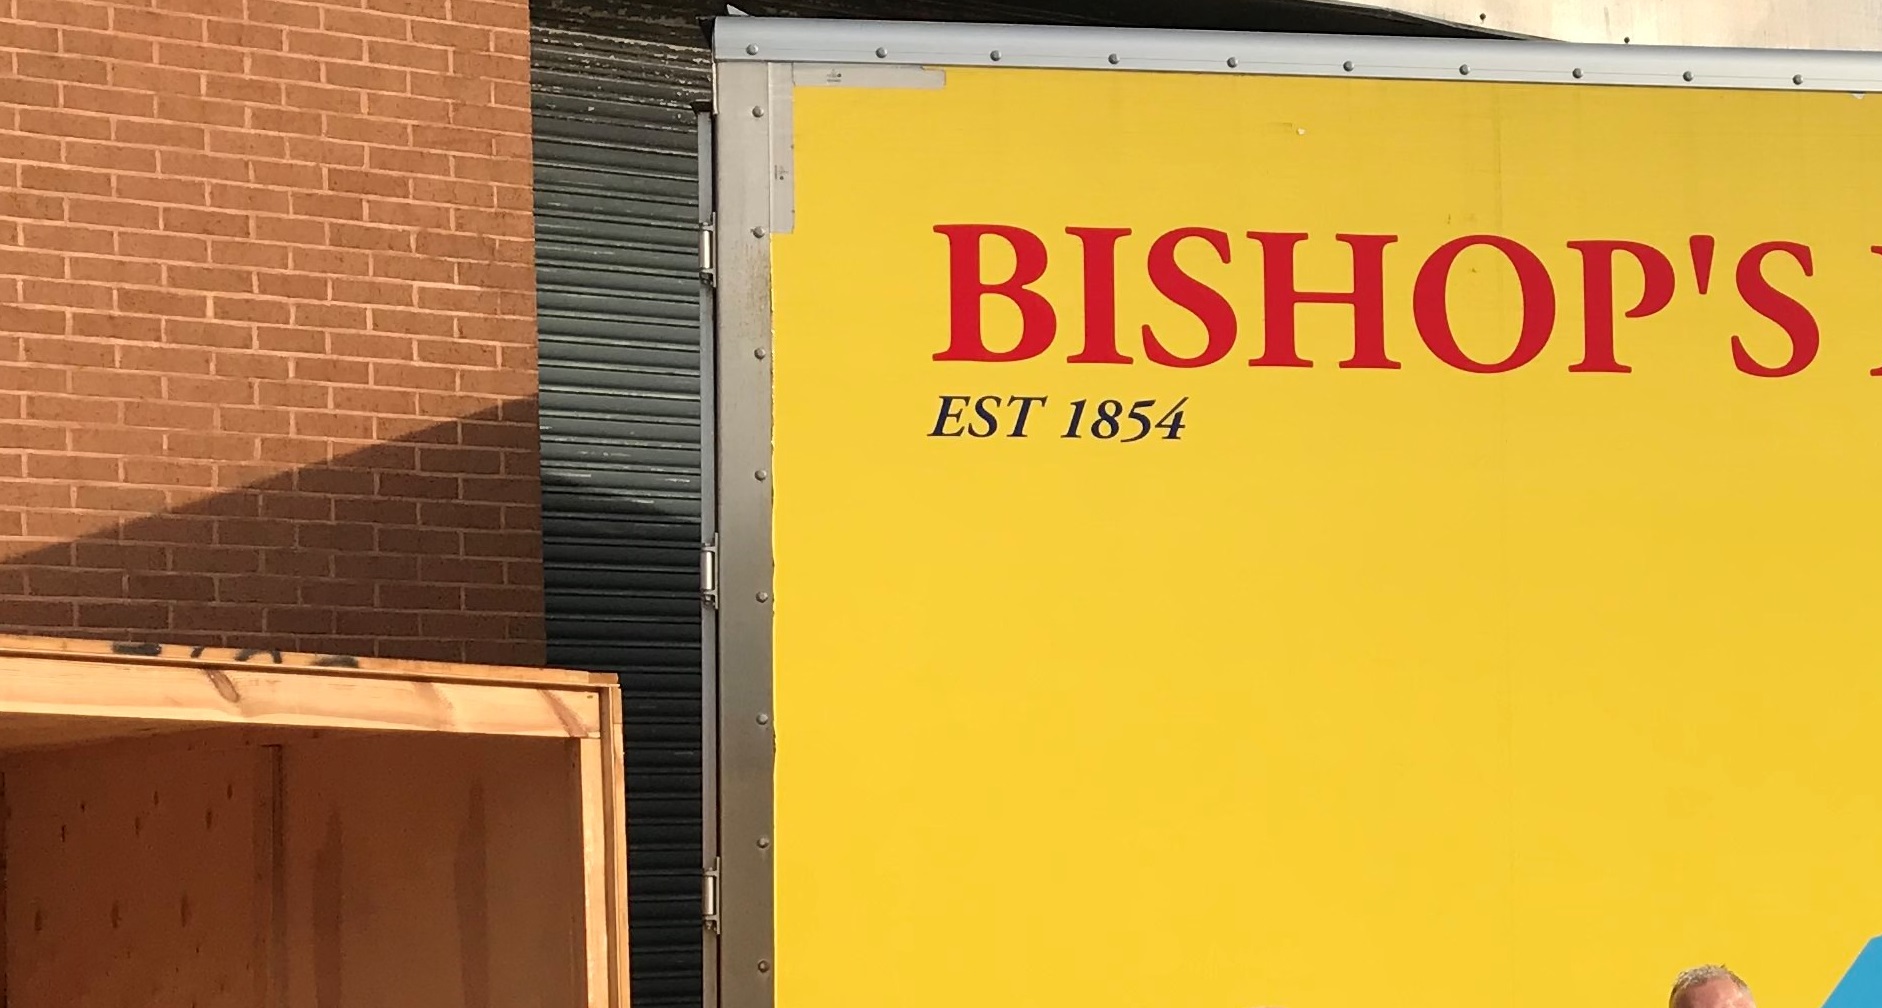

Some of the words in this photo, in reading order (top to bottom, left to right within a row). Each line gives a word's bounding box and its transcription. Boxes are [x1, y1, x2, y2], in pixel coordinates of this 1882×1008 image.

[932, 223, 1820, 378] BISHOP'S
[927, 395, 1048, 438] EST
[1060, 397, 1188, 443] 1854
